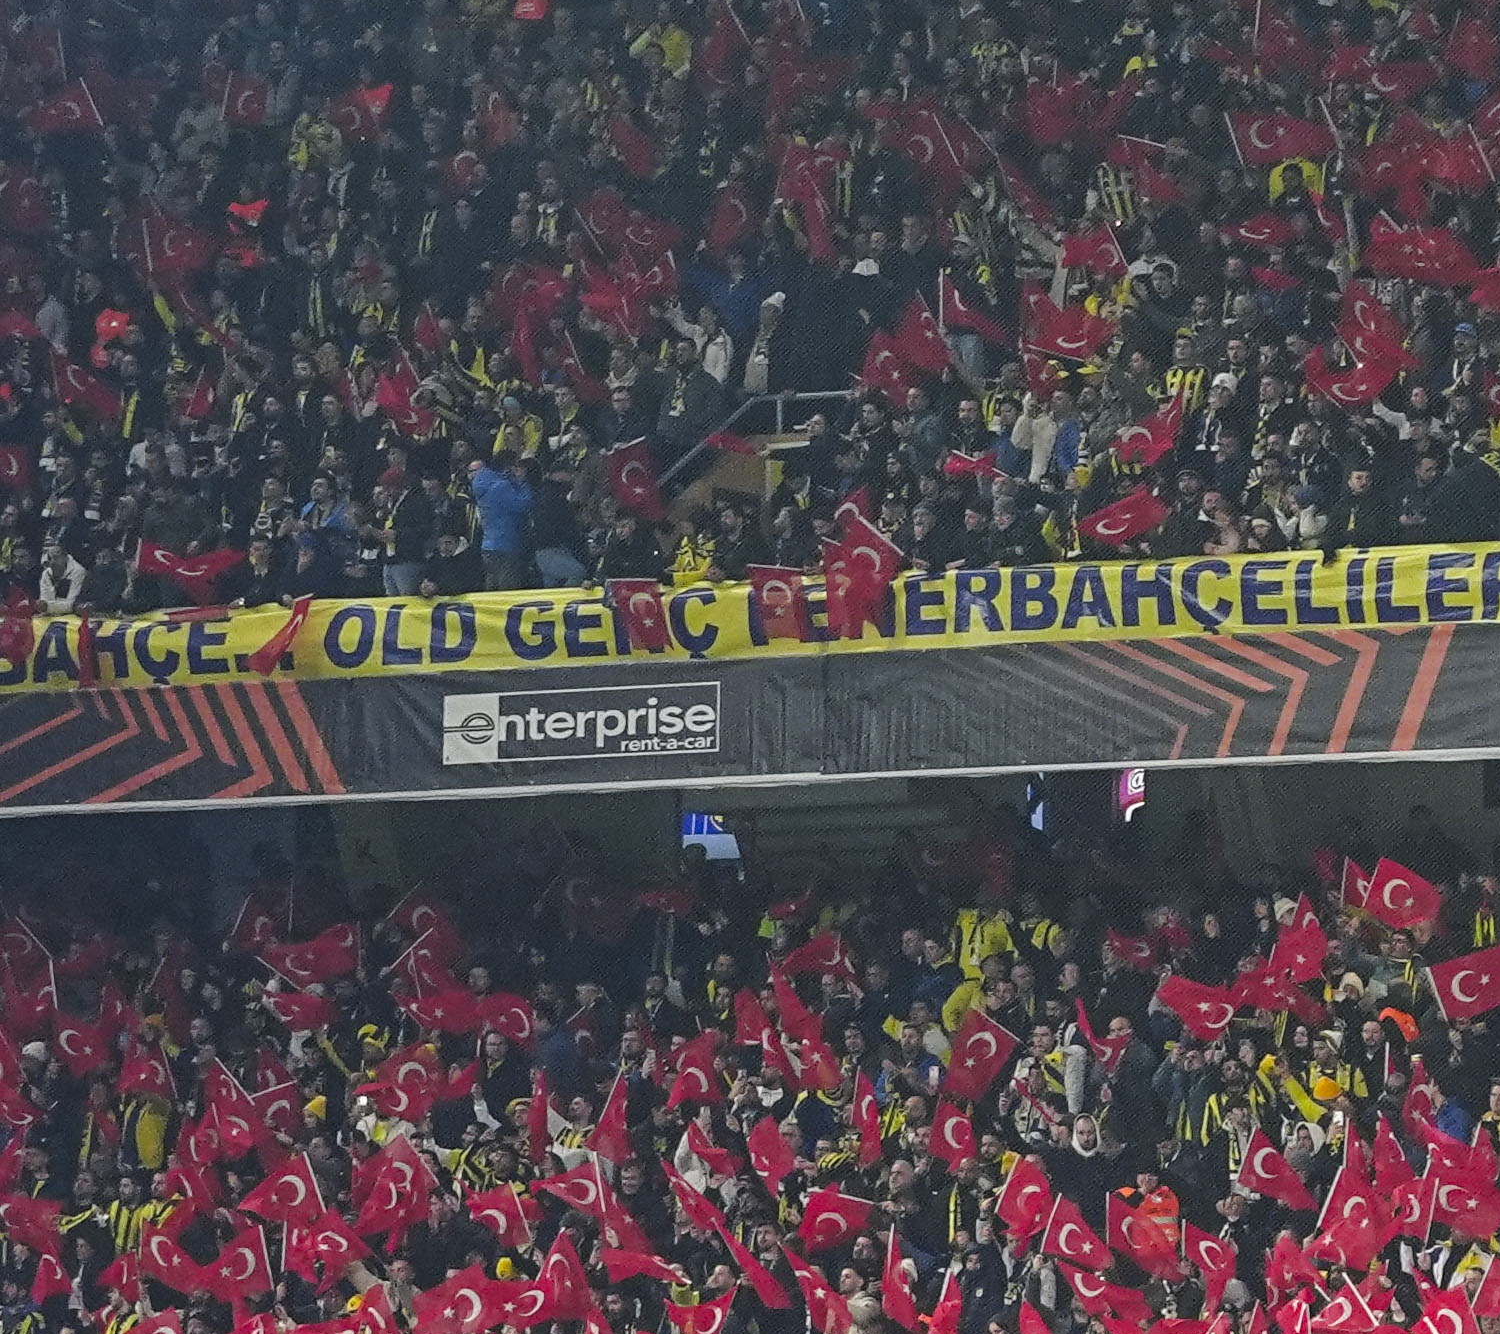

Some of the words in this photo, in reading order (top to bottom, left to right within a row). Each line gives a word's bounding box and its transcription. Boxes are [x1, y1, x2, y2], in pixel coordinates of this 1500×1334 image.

[323, 599, 478, 668] OLD
[504, 588, 719, 662] GEÇ
[619, 733, 716, 753] rent-a-car
